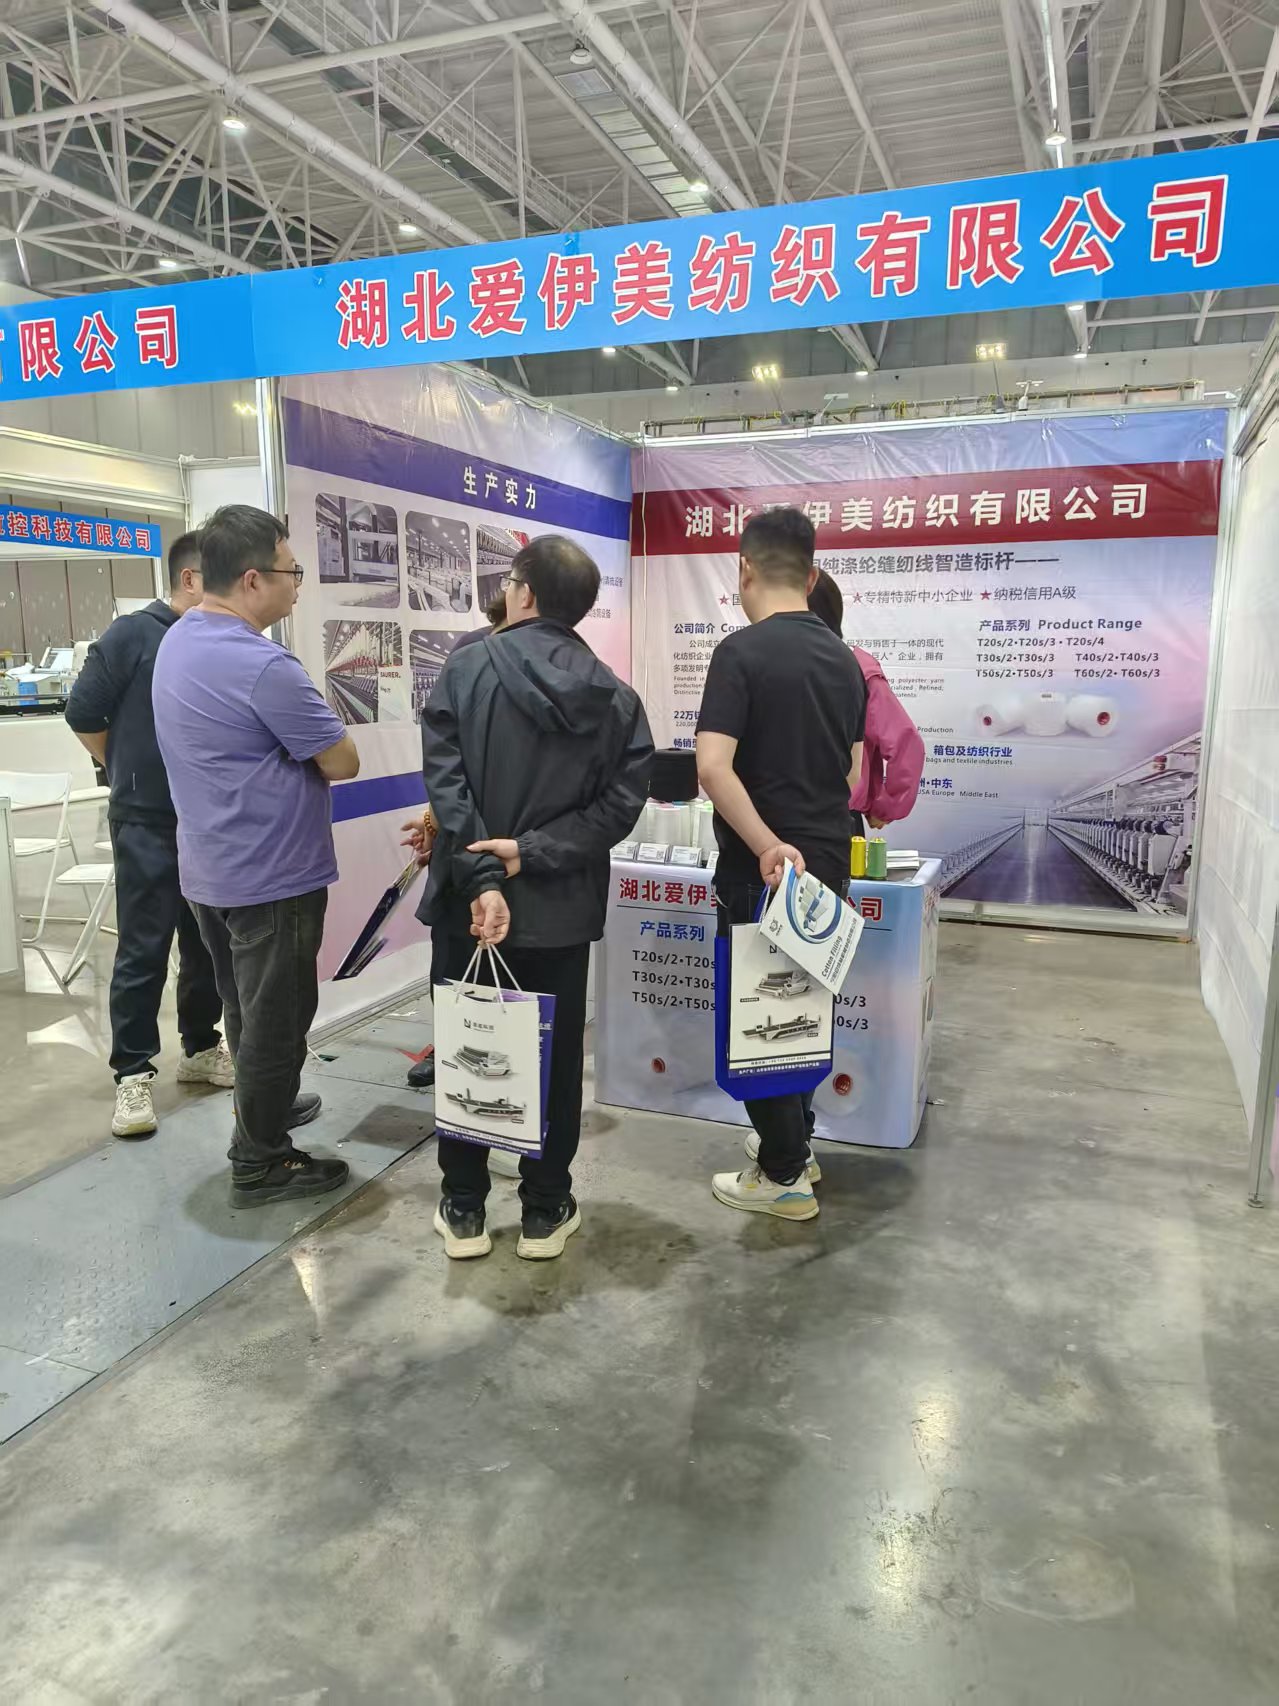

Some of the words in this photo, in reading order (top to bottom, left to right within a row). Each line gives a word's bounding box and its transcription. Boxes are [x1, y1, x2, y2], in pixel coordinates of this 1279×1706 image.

[336, 174, 1229, 350] 湖北爱伊美纺织有限公司
[0, 305, 179, 381] 限公司
[464, 465, 536, 510] 生产实力
[685, 483, 1147, 538] 湖北伊美纺织有限公司
[0, 511, 151, 551] 控科技有限公司
[864, 588, 973, 604] 专精特新中小企业
[994, 585, 1076, 600] 纳税信用A级
[674, 623, 715, 634] 公司简介
[979, 619, 1030, 632] 产品系列
[1038, 618, 1093, 630] Product
[1097, 618, 1142, 631] Range
[933, 745, 1013, 758] 箱包及纺织行业
[640, 920, 705, 942] 产品系列
[821, 955, 834, 977] Cotton
[830, 935, 843, 957] Filling
[833, 1015, 869, 1030] 0s/3
